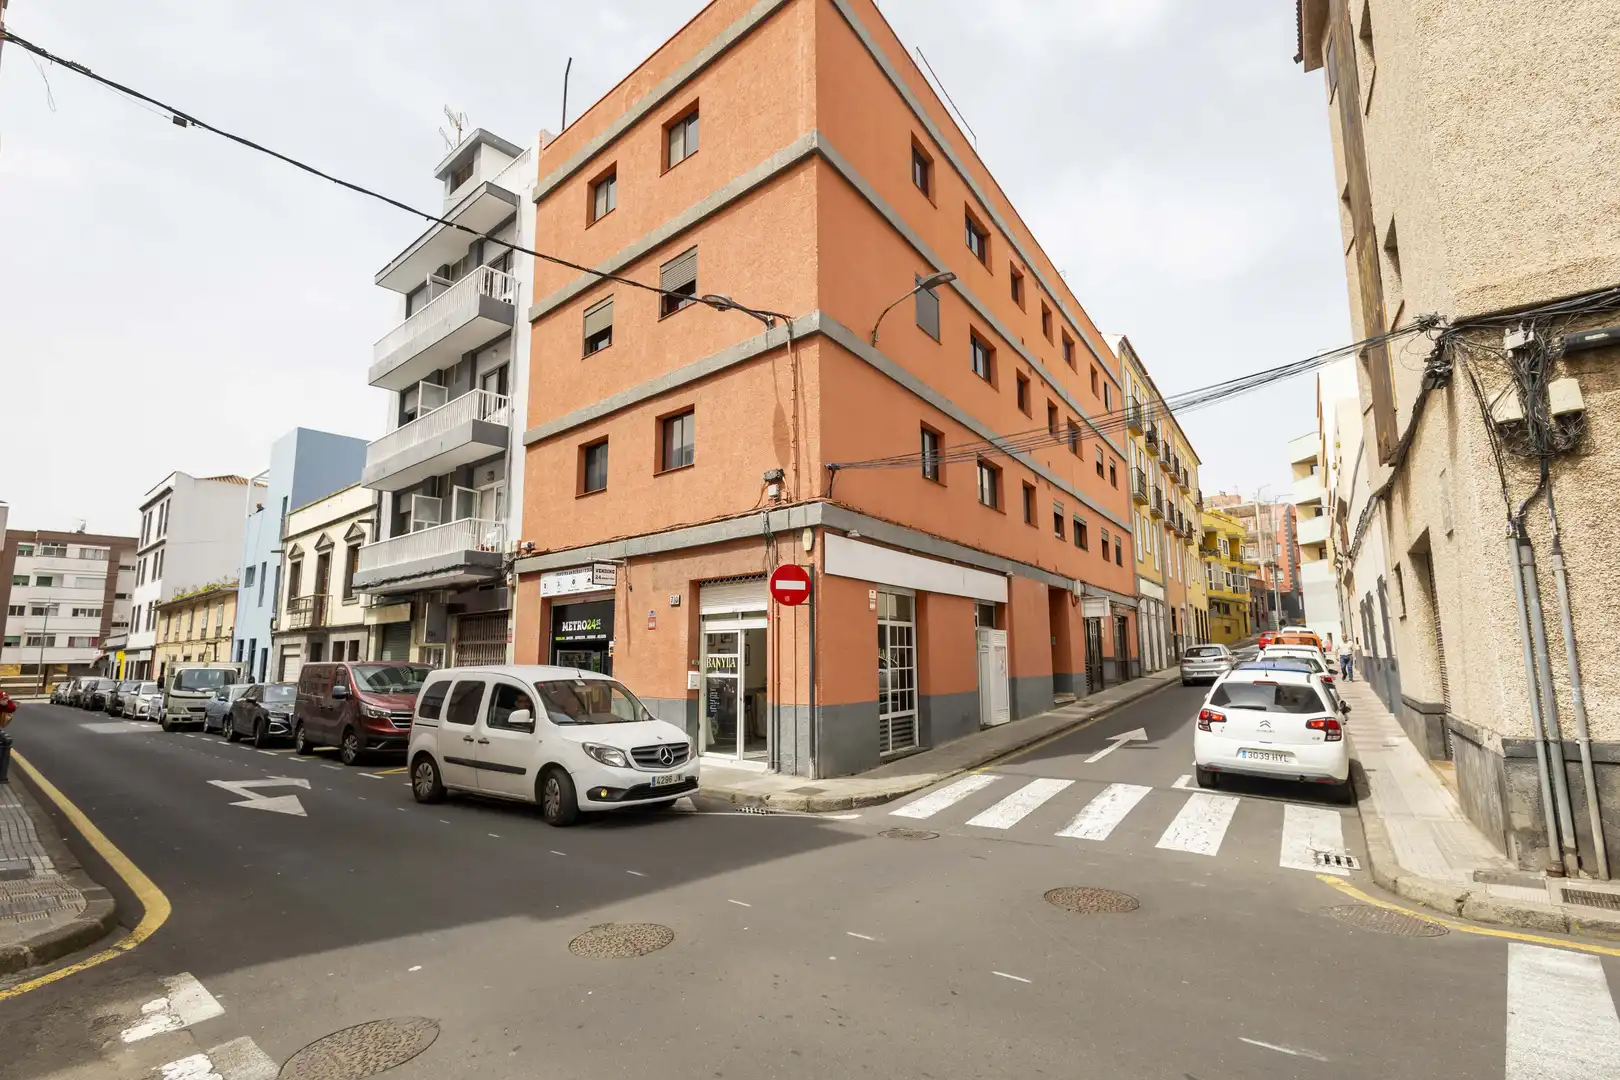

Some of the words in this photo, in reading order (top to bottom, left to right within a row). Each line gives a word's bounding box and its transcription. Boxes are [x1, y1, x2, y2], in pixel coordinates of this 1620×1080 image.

[1248, 751, 1270, 761] 3039
[1272, 753, 1289, 763] HYL
[656, 775, 672, 784] 4296
